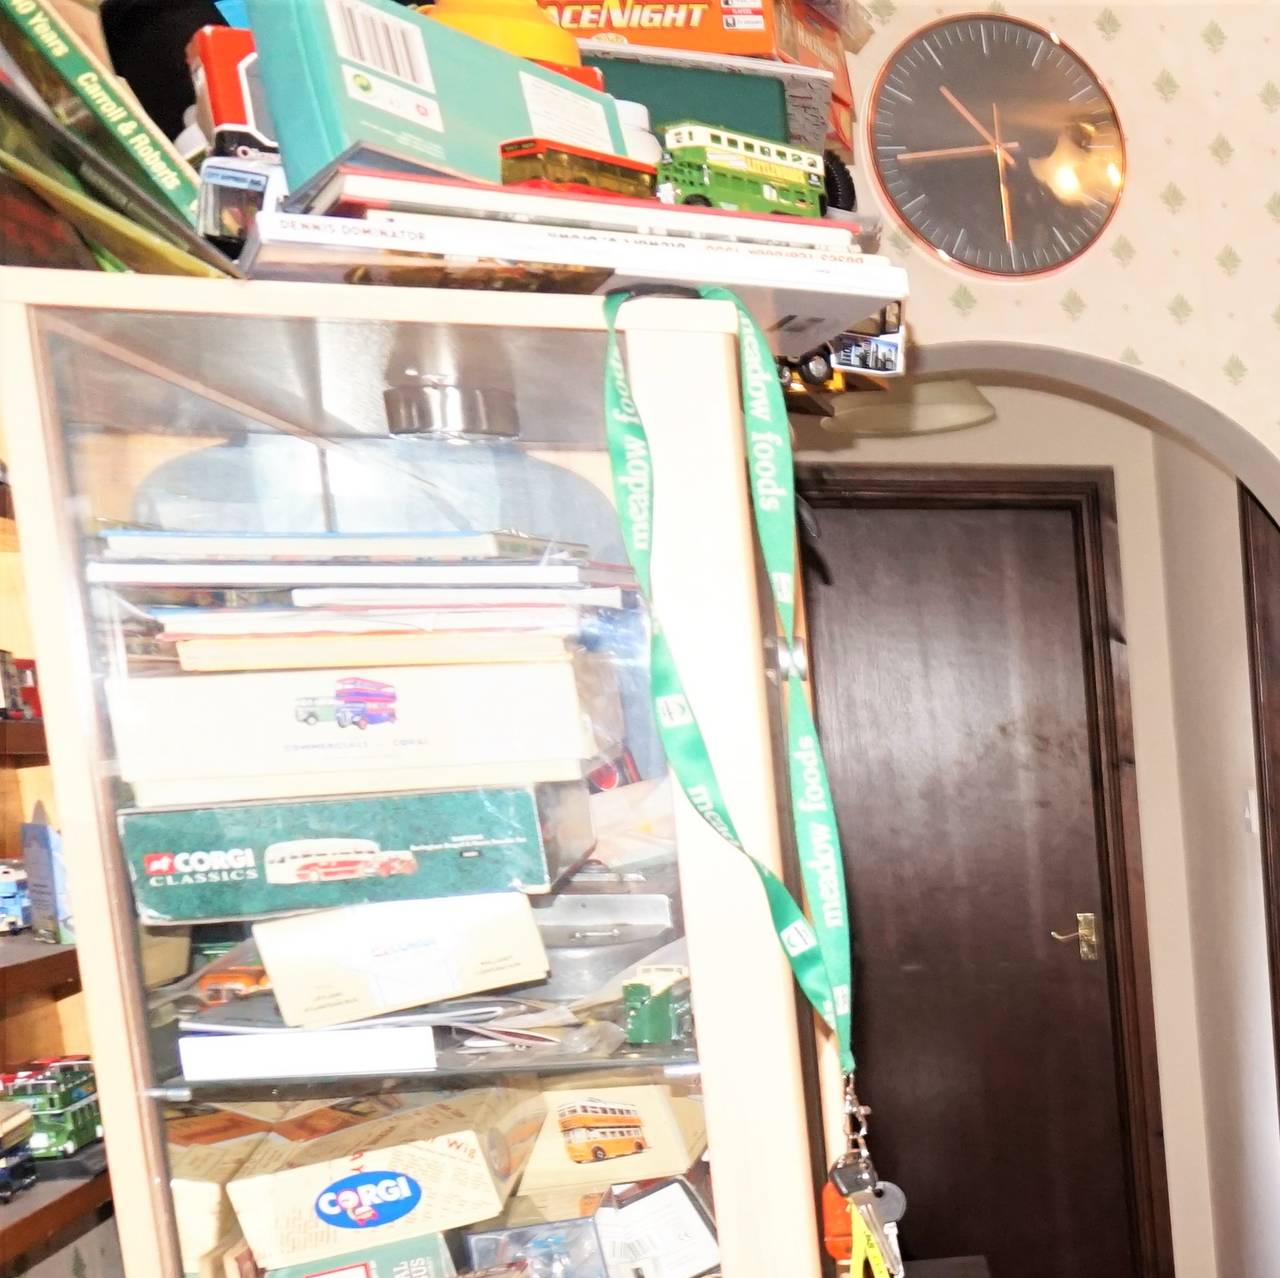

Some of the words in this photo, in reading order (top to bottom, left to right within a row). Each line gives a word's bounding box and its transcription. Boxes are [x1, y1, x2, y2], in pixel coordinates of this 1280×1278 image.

[28, 12, 70, 58] Years
[76, 70, 128, 125] Carroll
[116, 119, 132, 138] &
[128, 132, 181, 191] Roberts
[626, 433, 653, 551] meadow
[752, 430, 790, 513] foods
[794, 735, 828, 813] foods
[148, 867, 260, 888] CLASSICS
[173, 848, 258, 874] CORGI
[809, 820, 844, 929] meadow
[317, 1176, 413, 1215] CORGI
